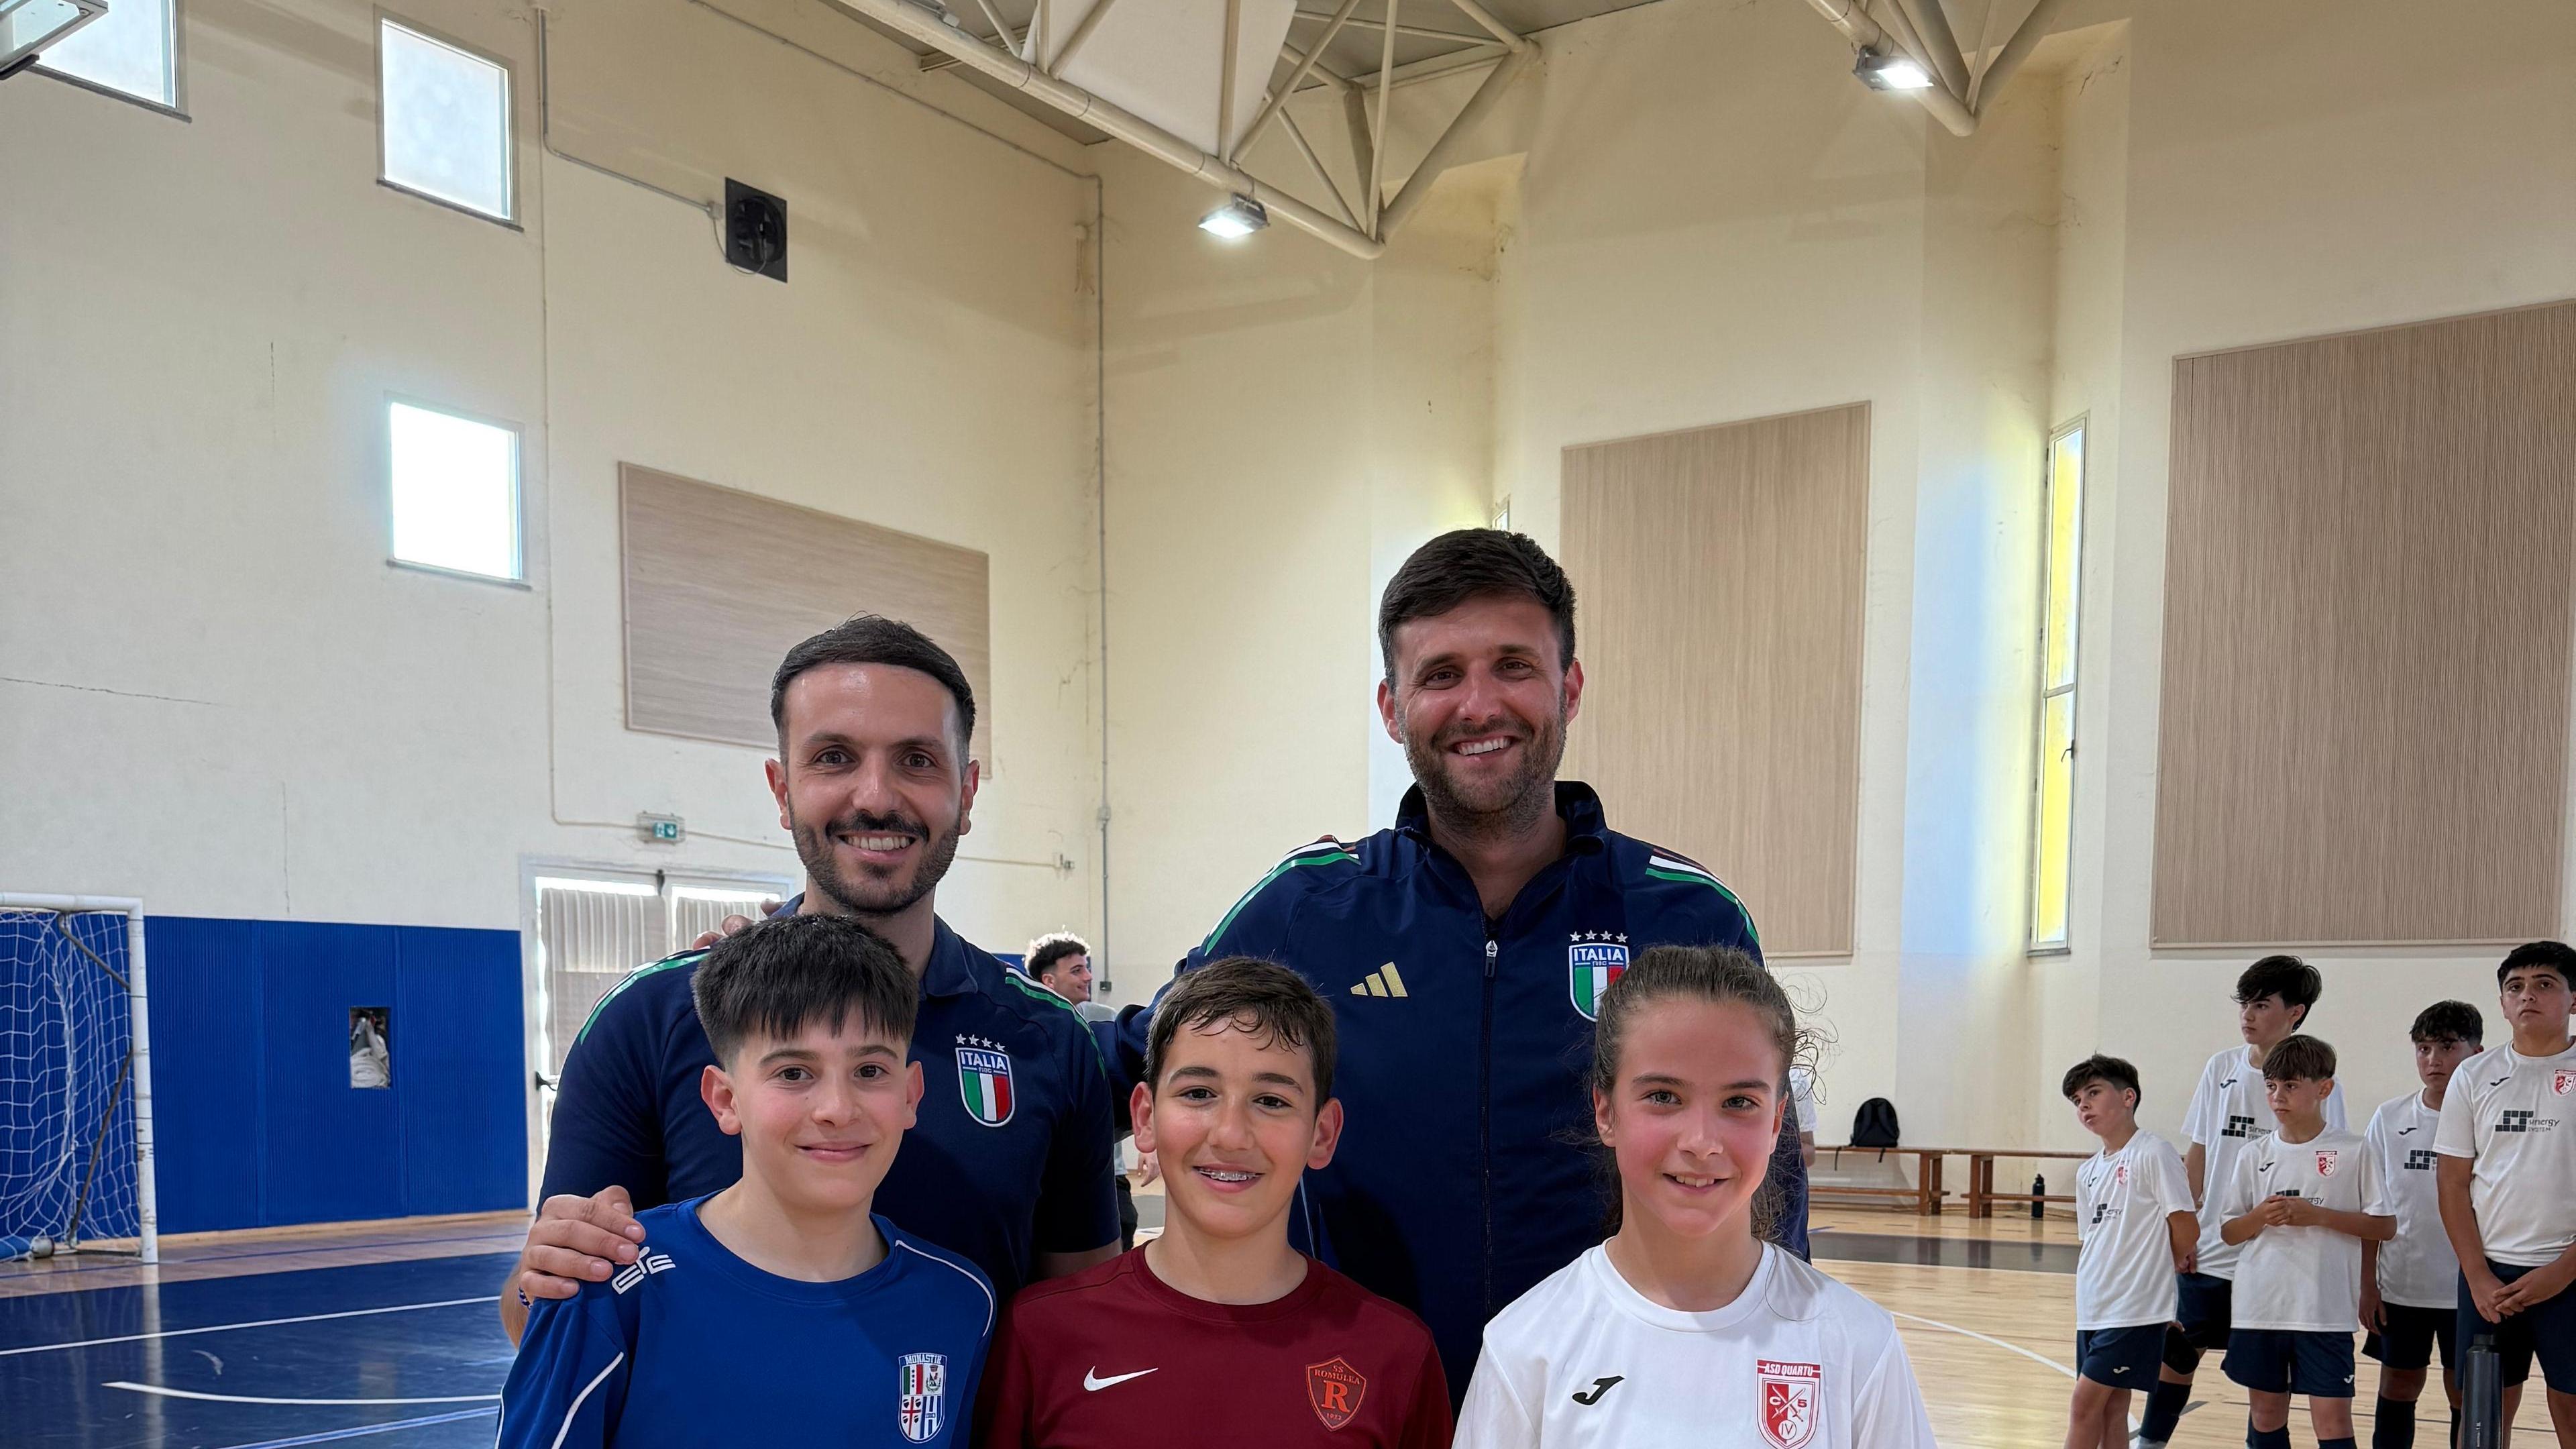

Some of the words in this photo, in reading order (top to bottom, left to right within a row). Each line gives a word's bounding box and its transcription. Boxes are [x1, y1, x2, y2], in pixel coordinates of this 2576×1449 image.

[1574, 949, 1623, 961] ITALIA
[960, 1051, 1007, 1070] ITALIA
[905, 1354, 942, 1364] MONASTIR
[1764, 1363, 1782, 1375] ASD
[1781, 1365, 1813, 1376] QUARTU
[1314, 1369, 1360, 1385] ROMULEA
[1321, 1379, 1351, 1413] R
[1770, 1396, 1782, 1405] C
[1797, 1399, 1807, 1408] 5
[1781, 1423, 1794, 1435] IV
